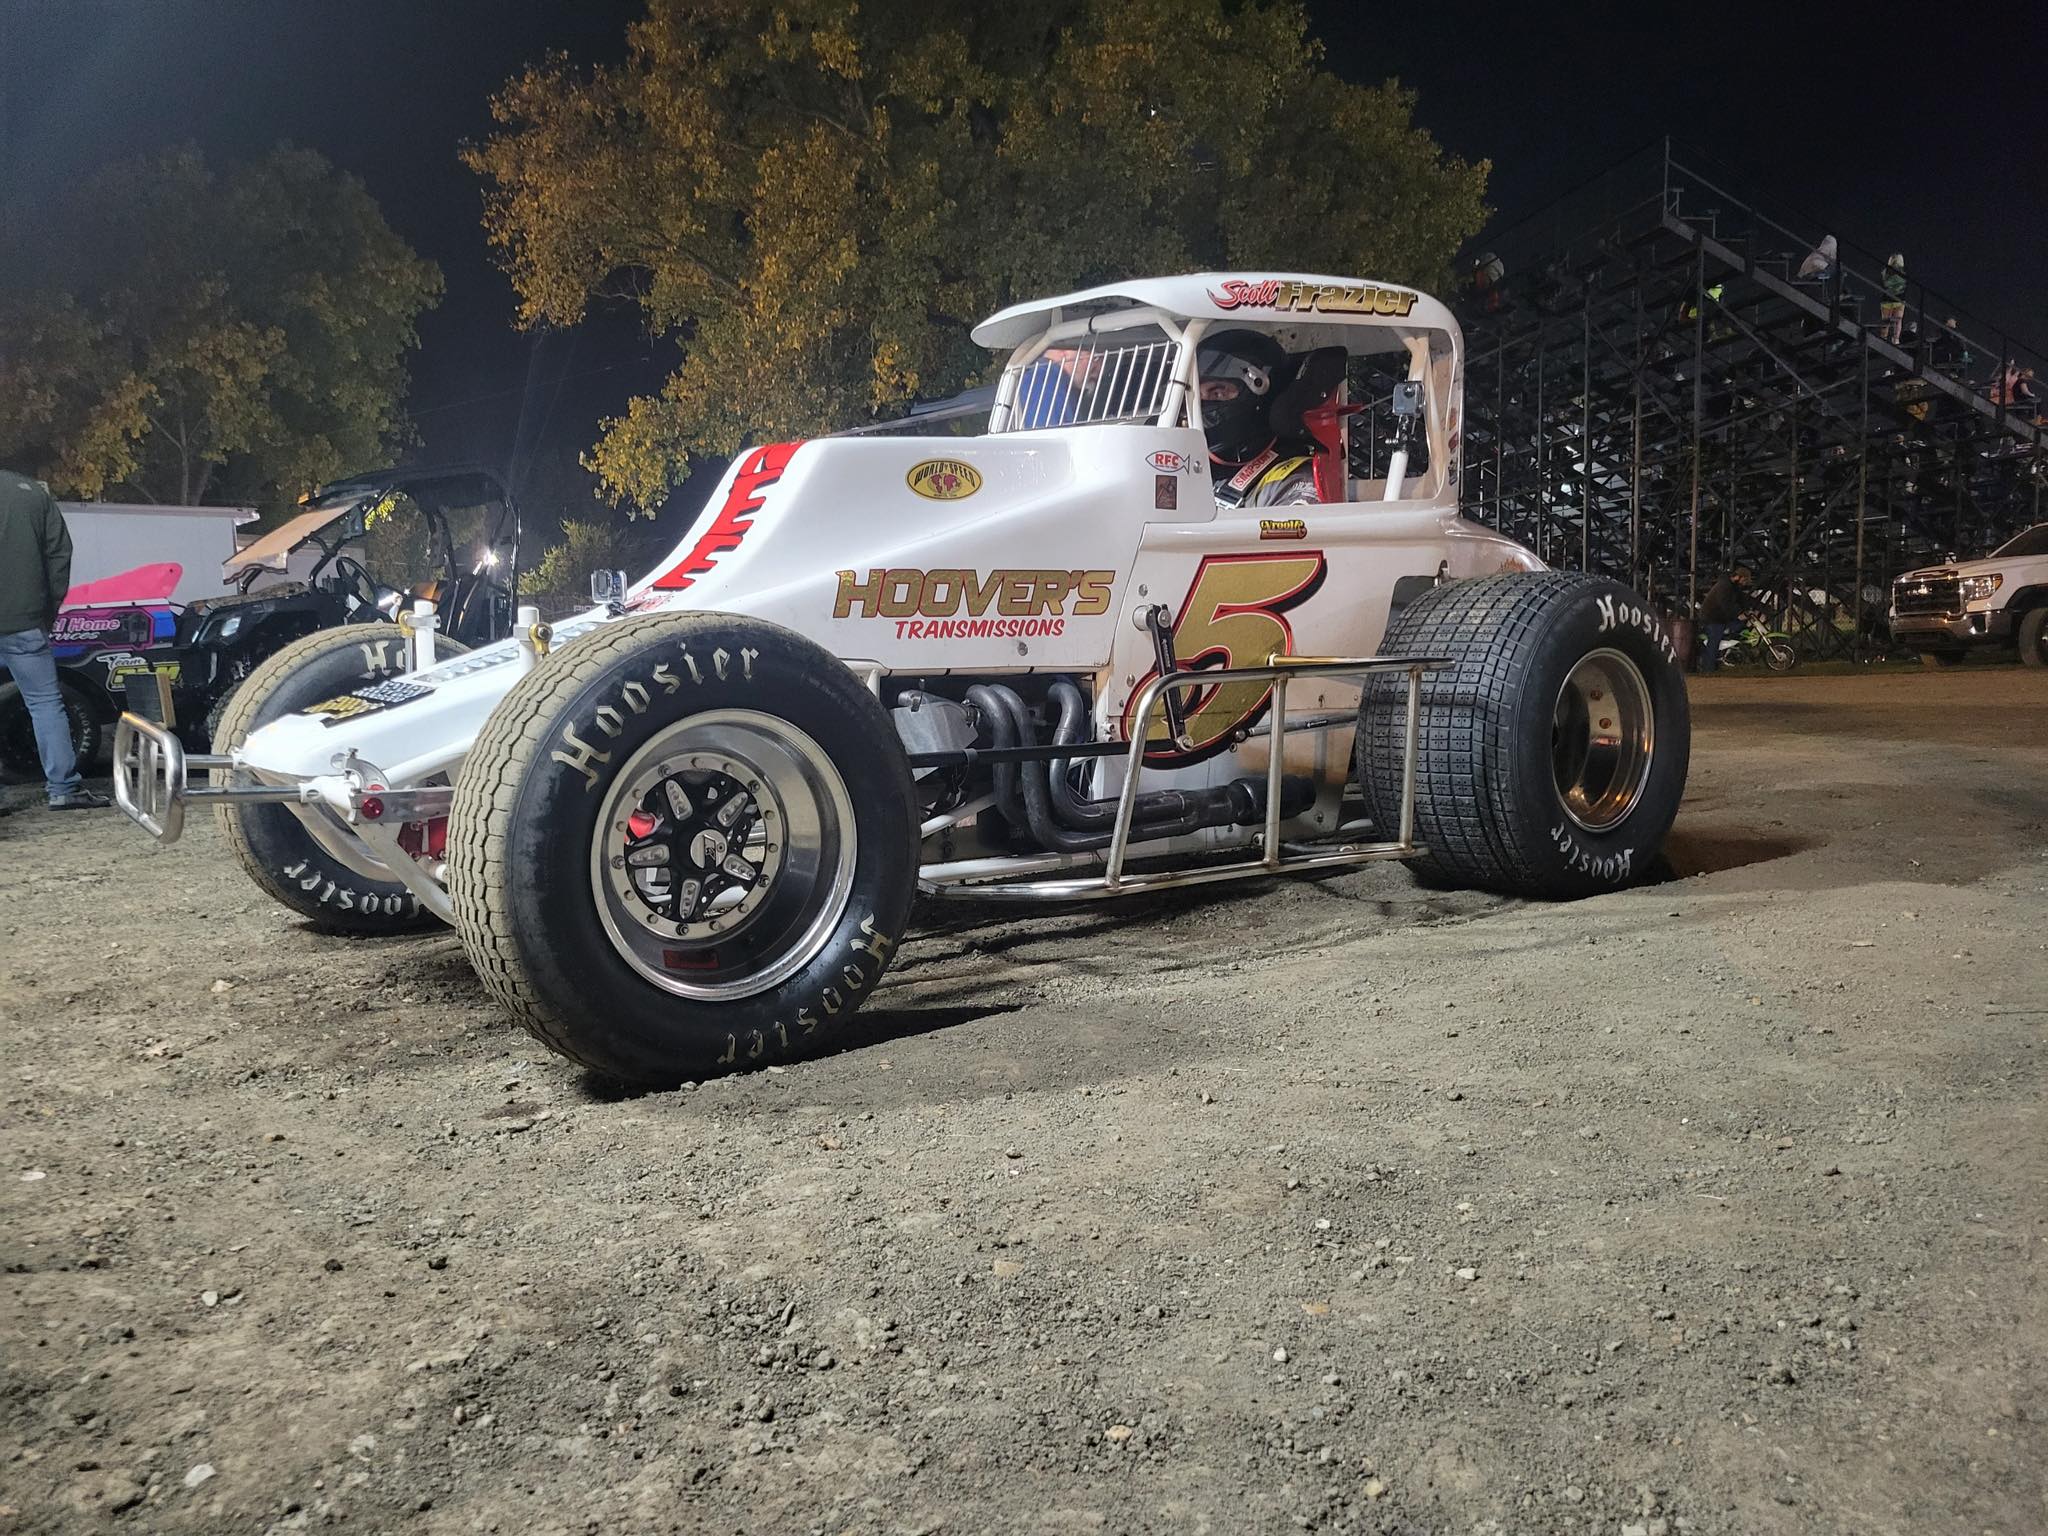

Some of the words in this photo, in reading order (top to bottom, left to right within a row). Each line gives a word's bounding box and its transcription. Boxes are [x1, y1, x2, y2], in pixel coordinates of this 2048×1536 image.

[1206, 280, 1281, 310] Scott
[1275, 280, 1418, 317] Frazier
[914, 462, 944, 487] WORLD
[949, 462, 976, 488] SPEED
[1155, 453, 1179, 467] RFC
[1235, 449, 1274, 486] SIMPSON
[832, 568, 1116, 618] HOOVER'S
[68, 618, 120, 632] Home
[895, 619, 1065, 640] TRANSMISSIONS
[1596, 594, 1677, 663] Hoosier
[97, 653, 147, 671] Team
[1120, 550, 1328, 770] 5
[551, 640, 761, 793] Hoosier
[1551, 822, 1634, 883] Hoosier
[716, 912, 893, 1065] Hoosier
